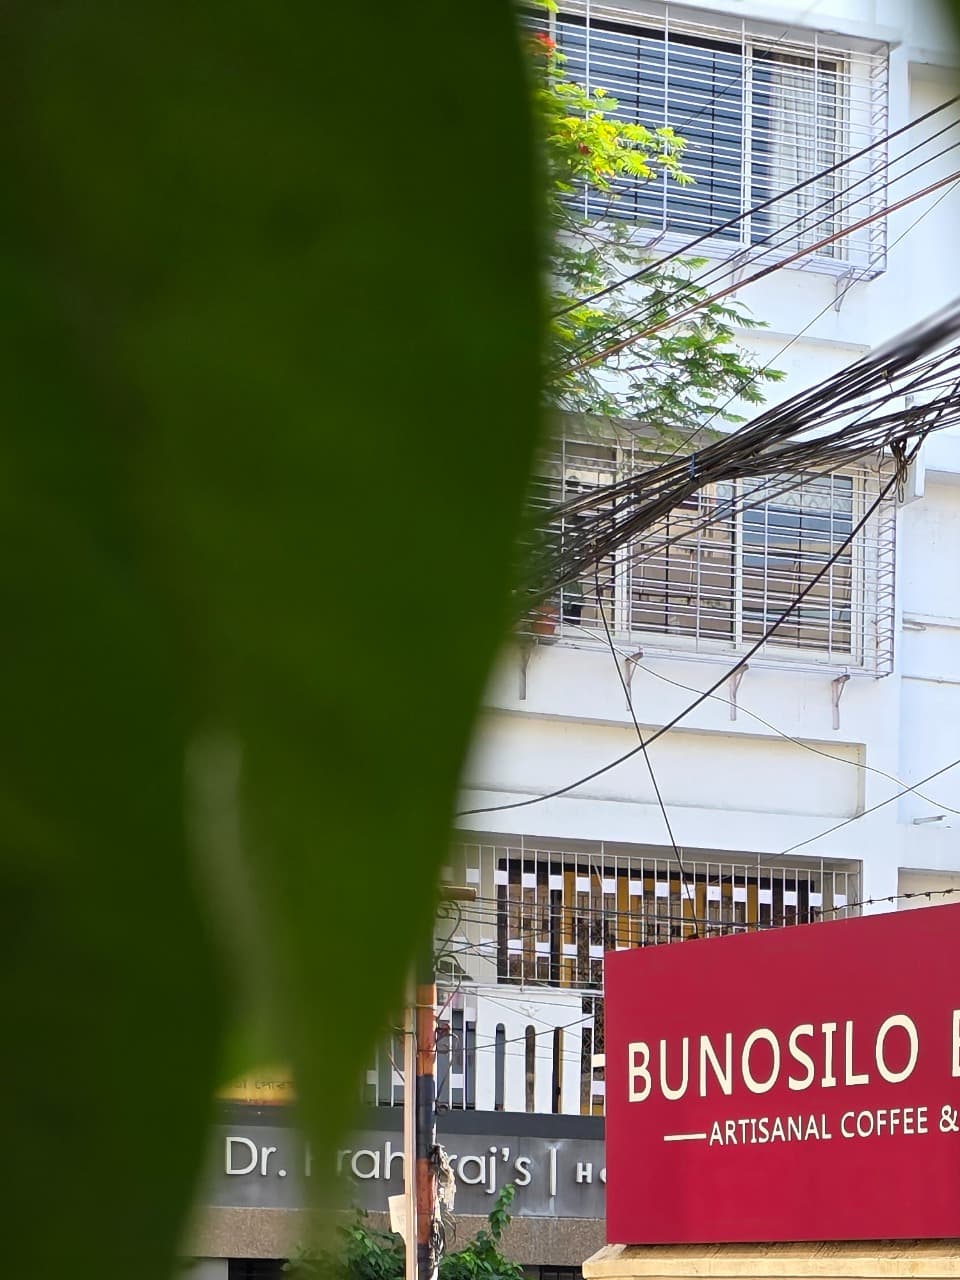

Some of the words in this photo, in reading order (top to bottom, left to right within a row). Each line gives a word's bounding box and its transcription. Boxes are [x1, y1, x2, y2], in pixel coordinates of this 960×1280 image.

[628, 1014, 919, 1103] BUNOSILO
[709, 1113, 832, 1146] ARTISANAL
[840, 1106, 928, 1138] COFFEE
[939, 1104, 960, 1133] &
[225, 1136, 288, 1177] Dr.
